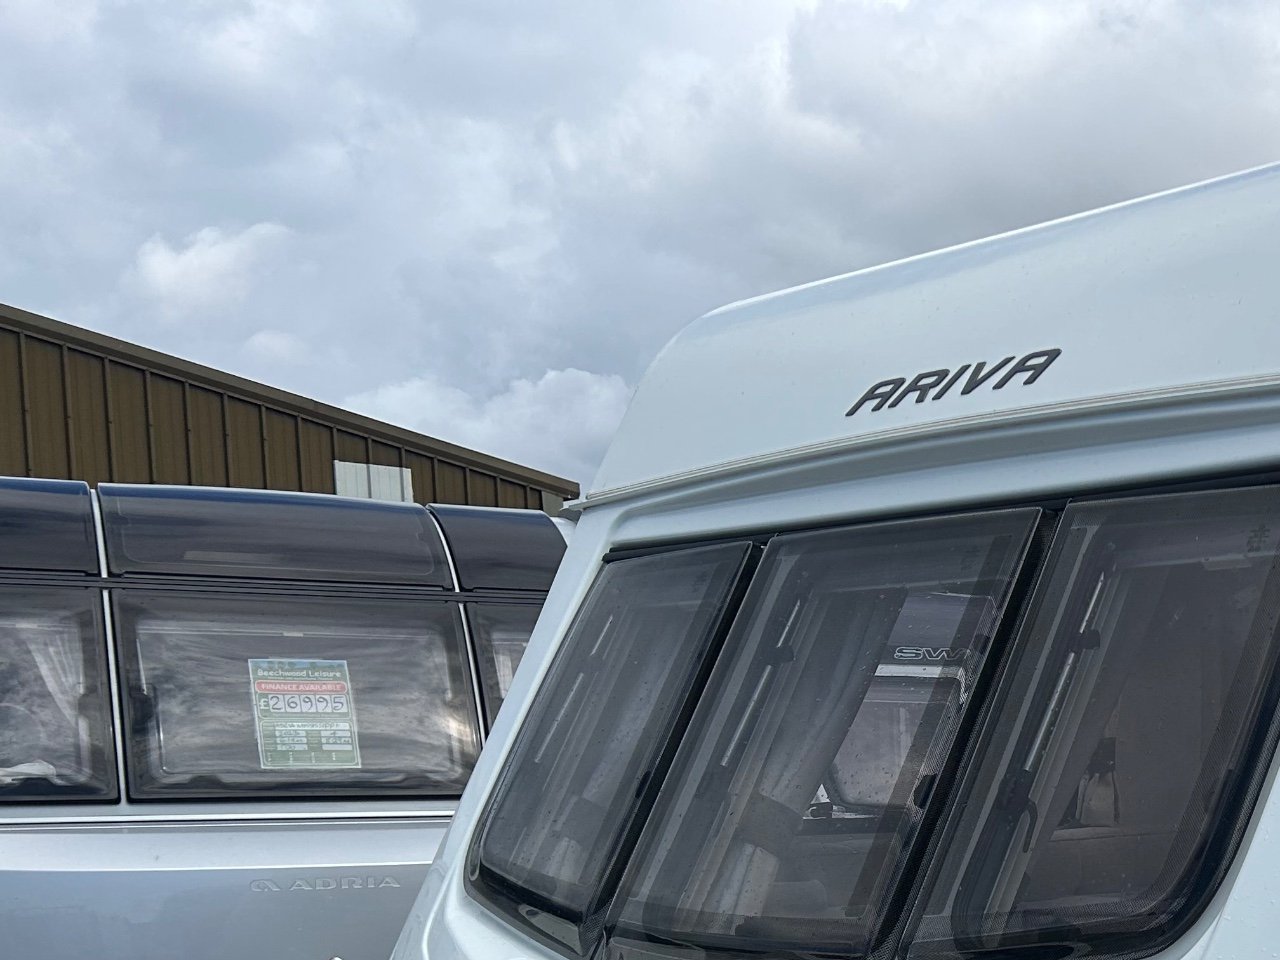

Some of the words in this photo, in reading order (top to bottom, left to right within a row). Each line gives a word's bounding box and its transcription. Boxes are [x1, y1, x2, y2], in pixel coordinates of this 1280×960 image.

[845, 348, 1062, 417] ARIVA
[257, 669, 306, 677] Beechwood
[309, 669, 341, 678] Leisure
[290, 876, 401, 891] ADRIA
